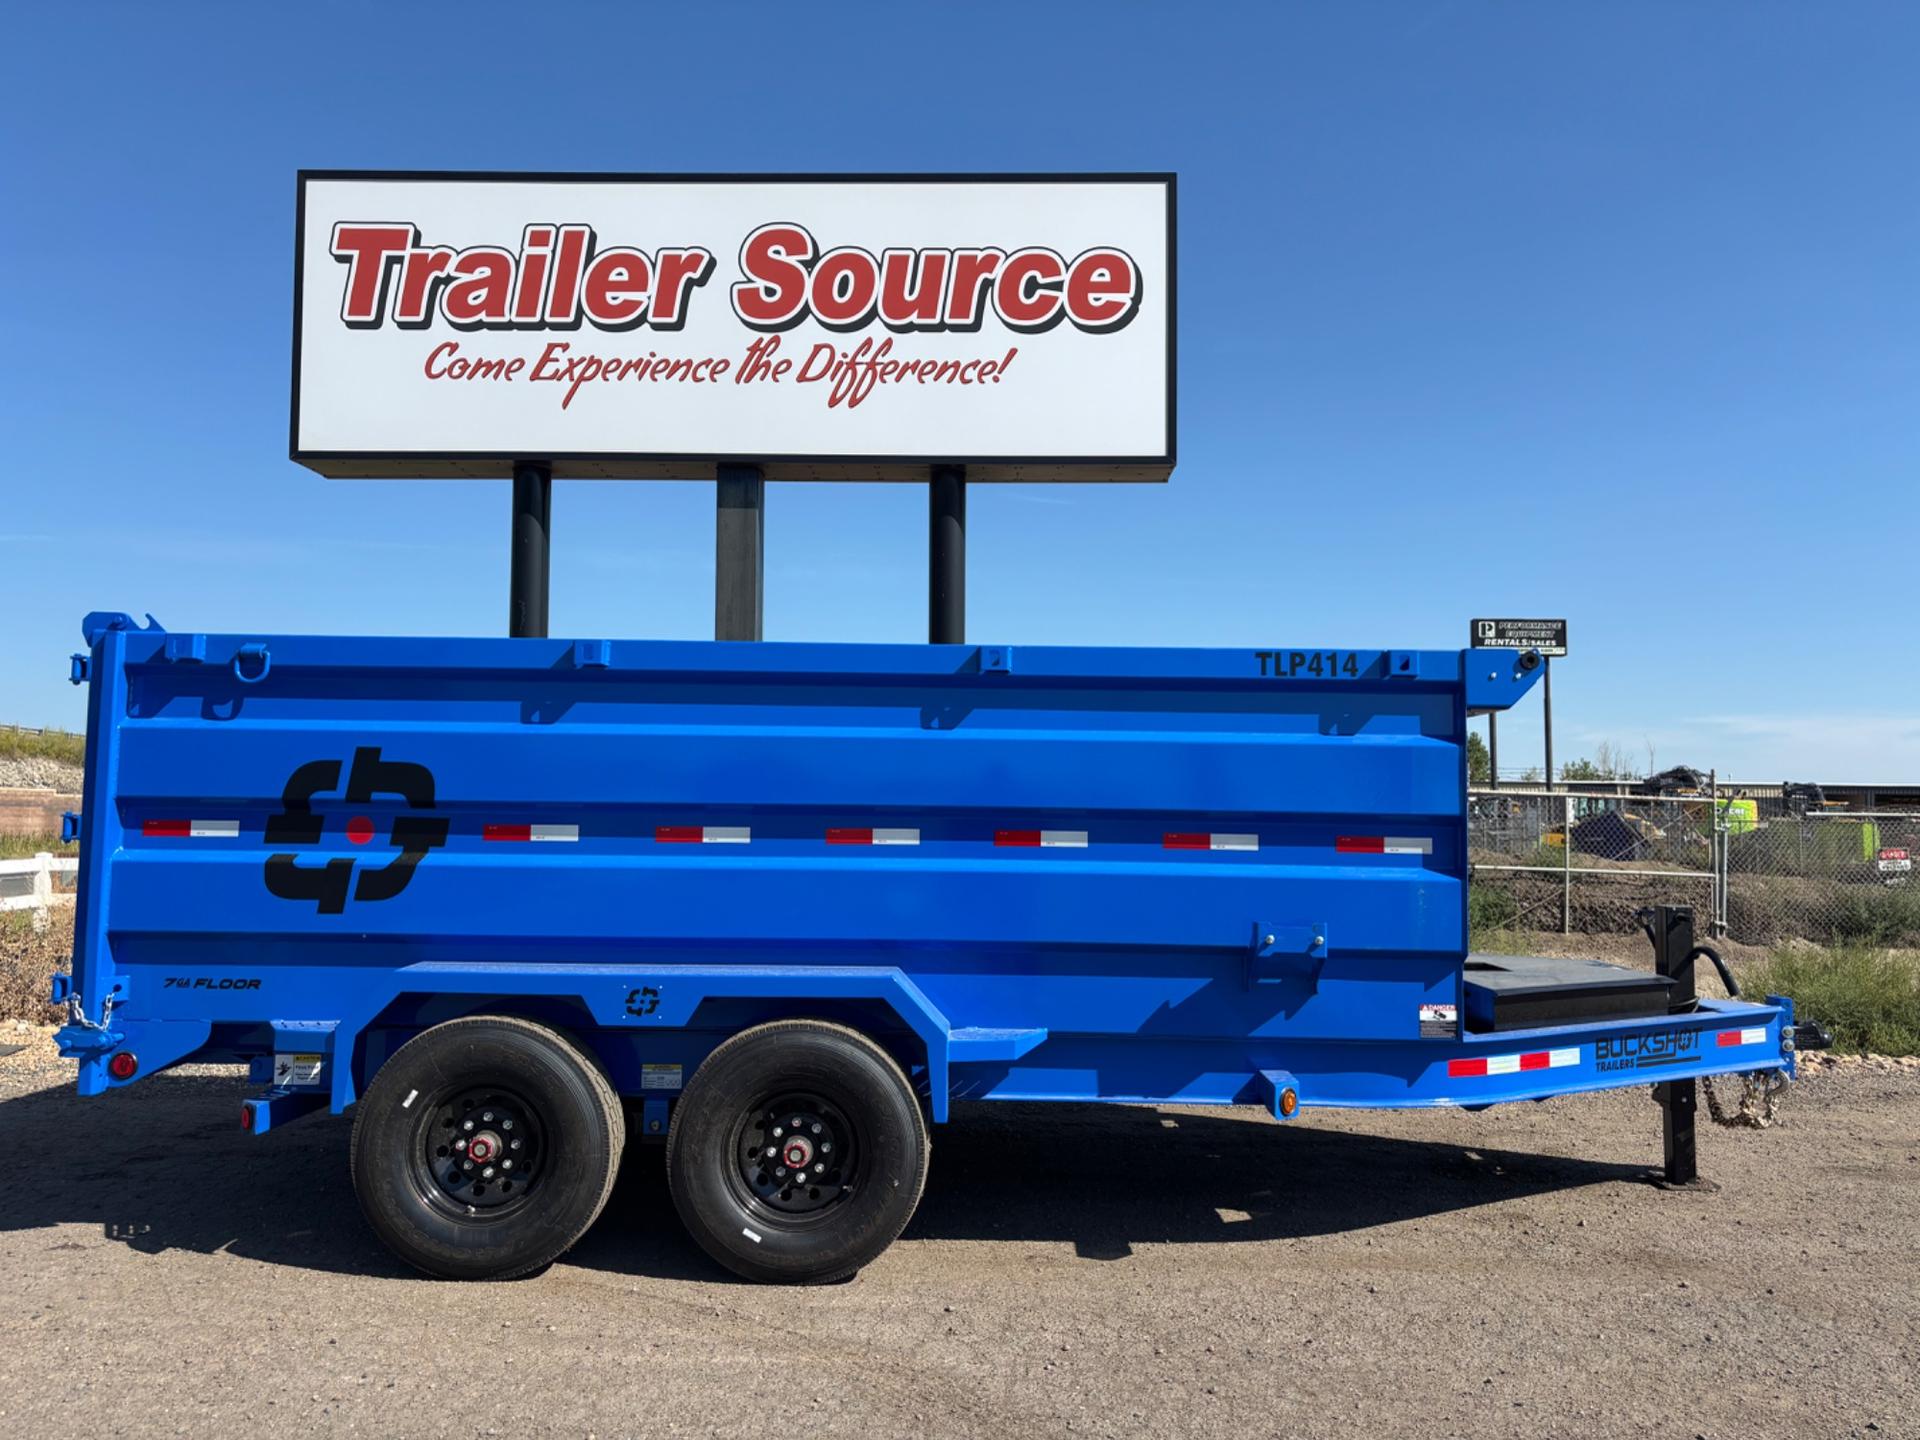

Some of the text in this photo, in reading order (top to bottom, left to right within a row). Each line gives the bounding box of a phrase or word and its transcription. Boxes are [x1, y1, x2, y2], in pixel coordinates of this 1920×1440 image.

[331, 223, 1141, 332] Trailer Source
[424, 334, 1018, 410] Come Experience the Difference!
[1255, 651, 1359, 678] TLP414
[193, 978, 262, 990] FLOOR
[1596, 1027, 1703, 1060] BUCKSHOT
[1596, 1058, 1634, 1072] TRAILERS
